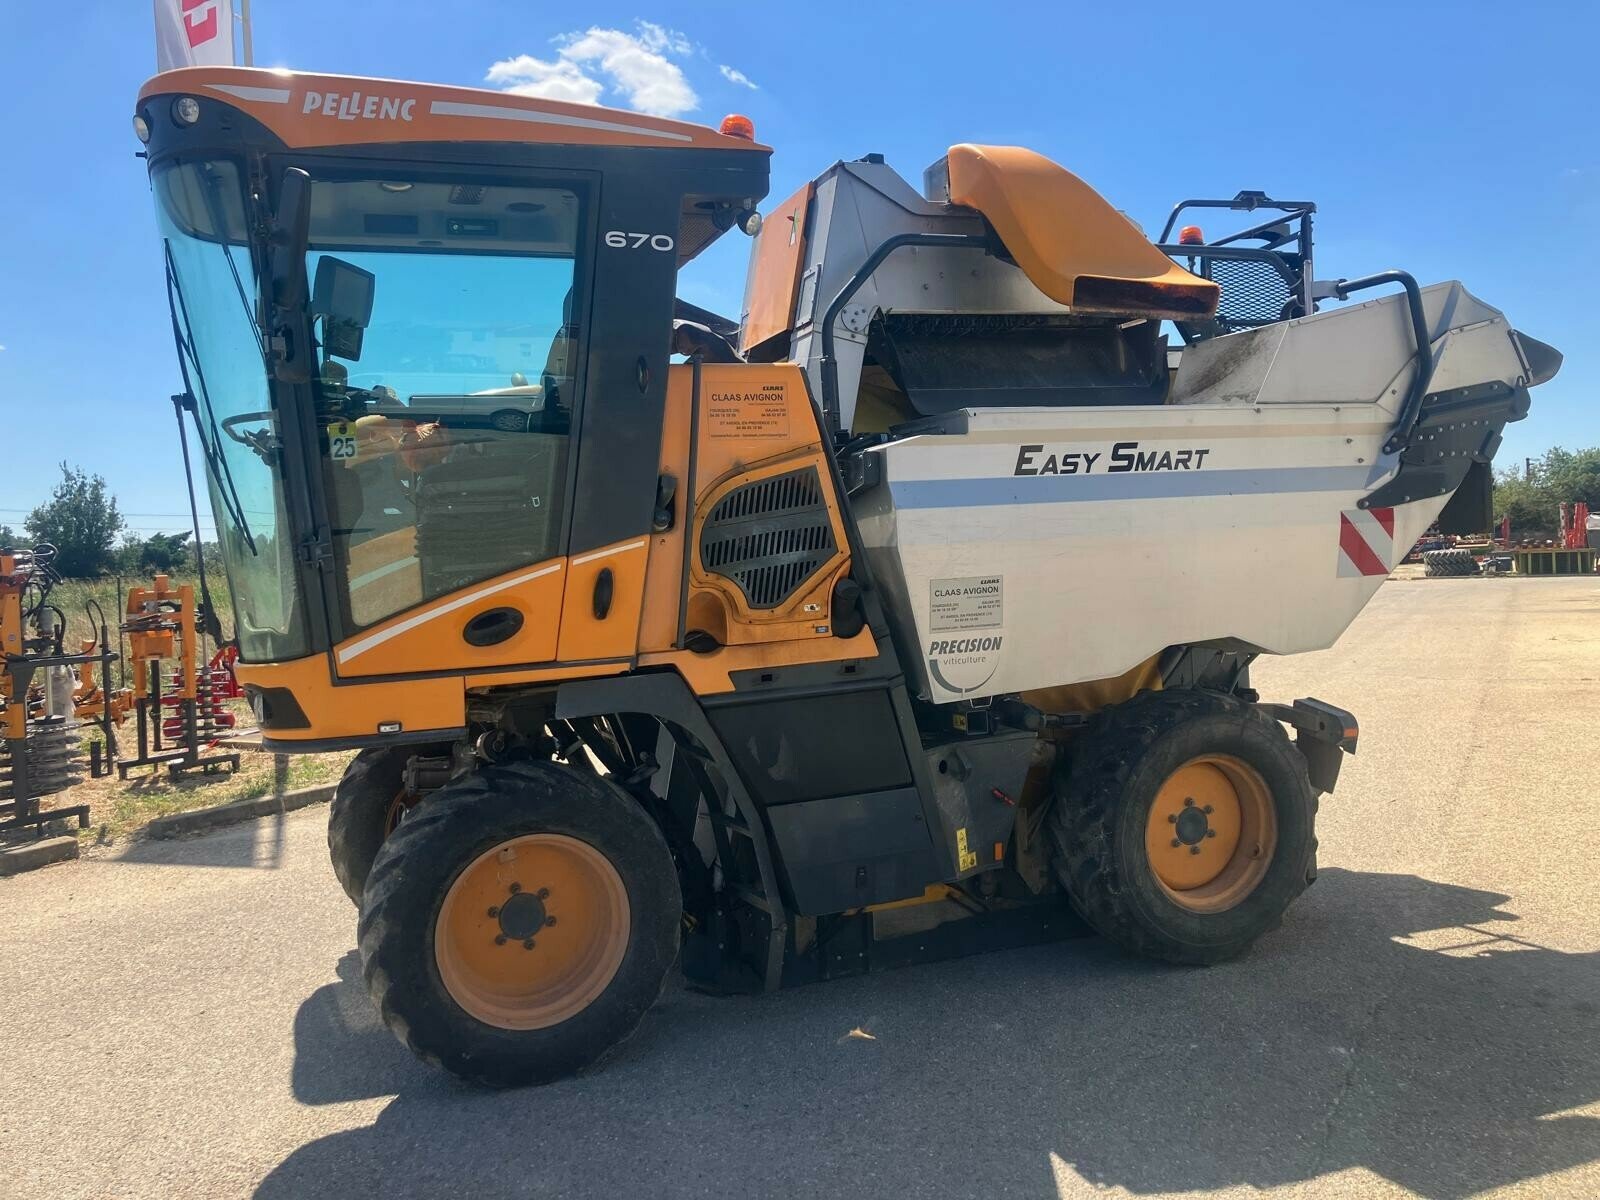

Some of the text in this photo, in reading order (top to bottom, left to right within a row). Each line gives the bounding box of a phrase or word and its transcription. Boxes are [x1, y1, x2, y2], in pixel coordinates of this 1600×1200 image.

[302, 91, 417, 121] PELLENC
[605, 230, 674, 252] 670
[711, 393, 783, 402] CLAAS AVIGNON
[333, 437, 356, 458] 25
[1014, 442, 1210, 476] EASY SMART
[934, 588, 961, 598] CLAAS
[963, 586, 999, 595] AVIGNON
[929, 636, 1003, 656] PRECISION
[944, 656, 986, 665] viticulture
